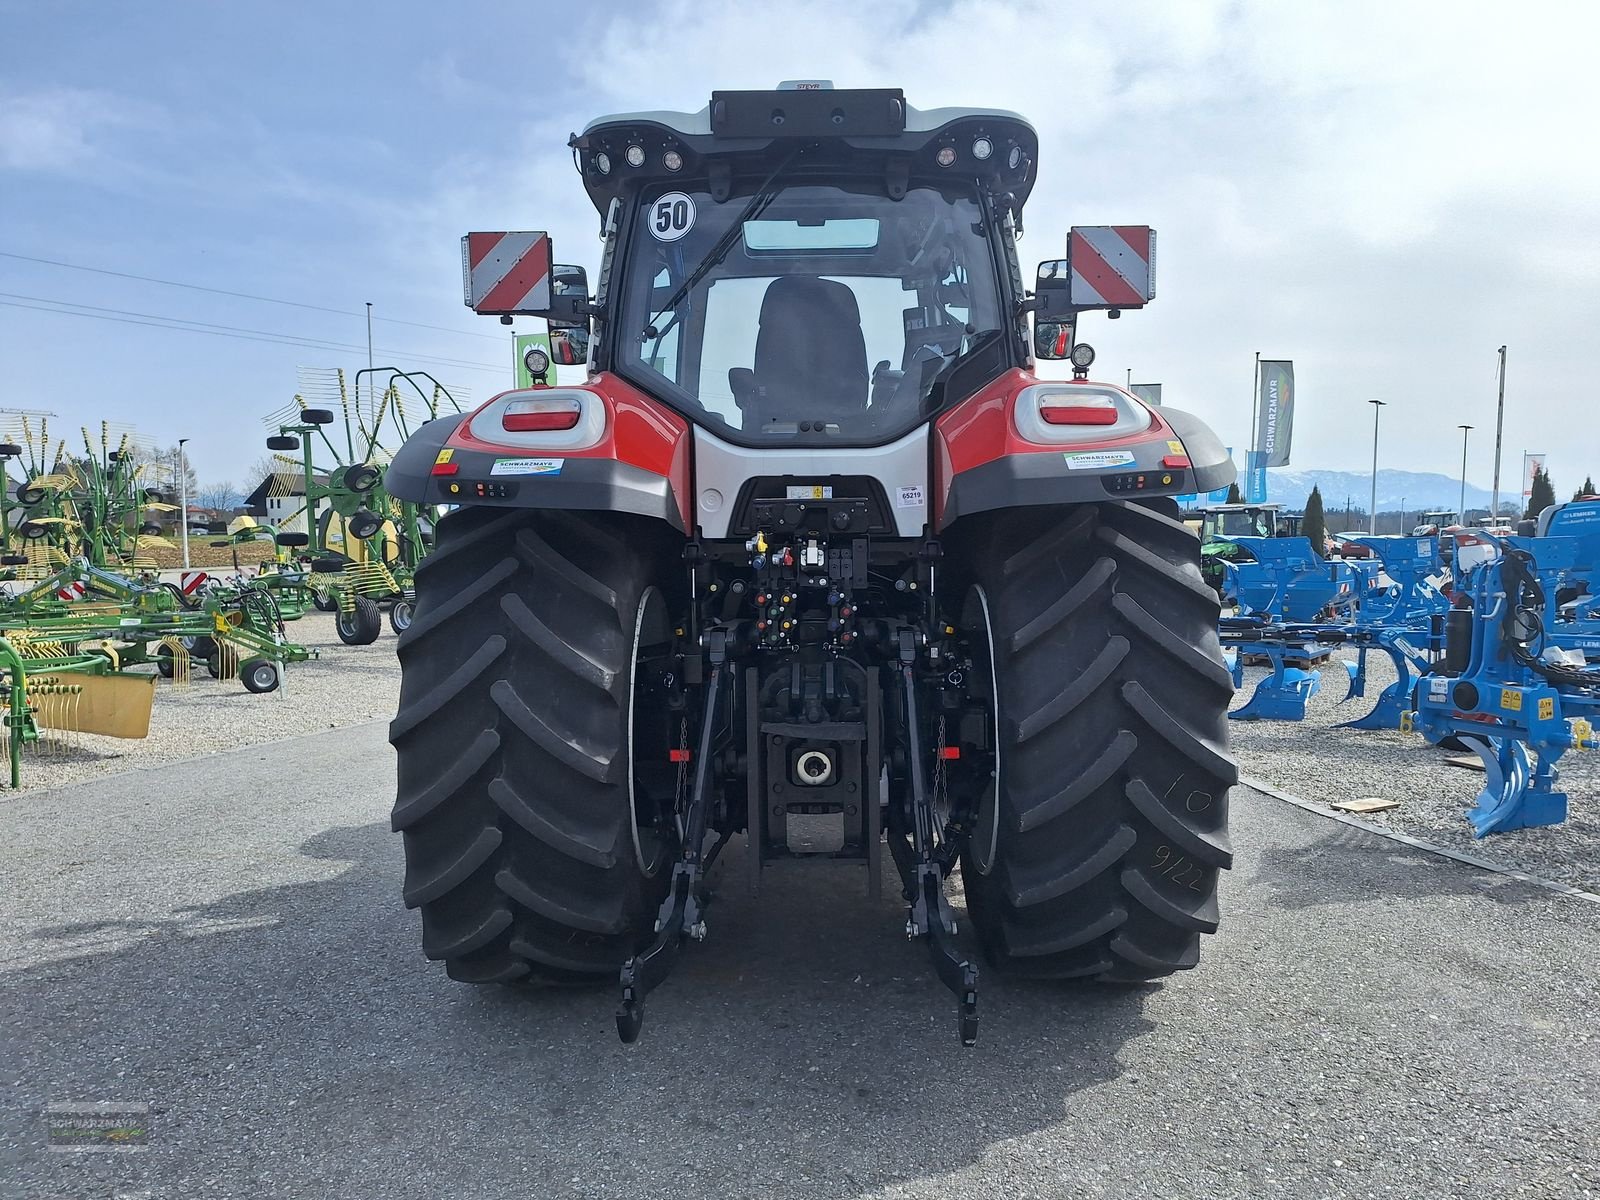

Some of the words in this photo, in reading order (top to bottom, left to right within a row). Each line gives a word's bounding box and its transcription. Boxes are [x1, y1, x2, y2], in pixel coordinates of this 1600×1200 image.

[656, 200, 688, 232] 50
[1265, 380, 1278, 455] SCHWARZMAYR
[902, 491, 921, 500] 65219
[1164, 773, 1212, 812] 10
[1150, 845, 1203, 892] 9/22
